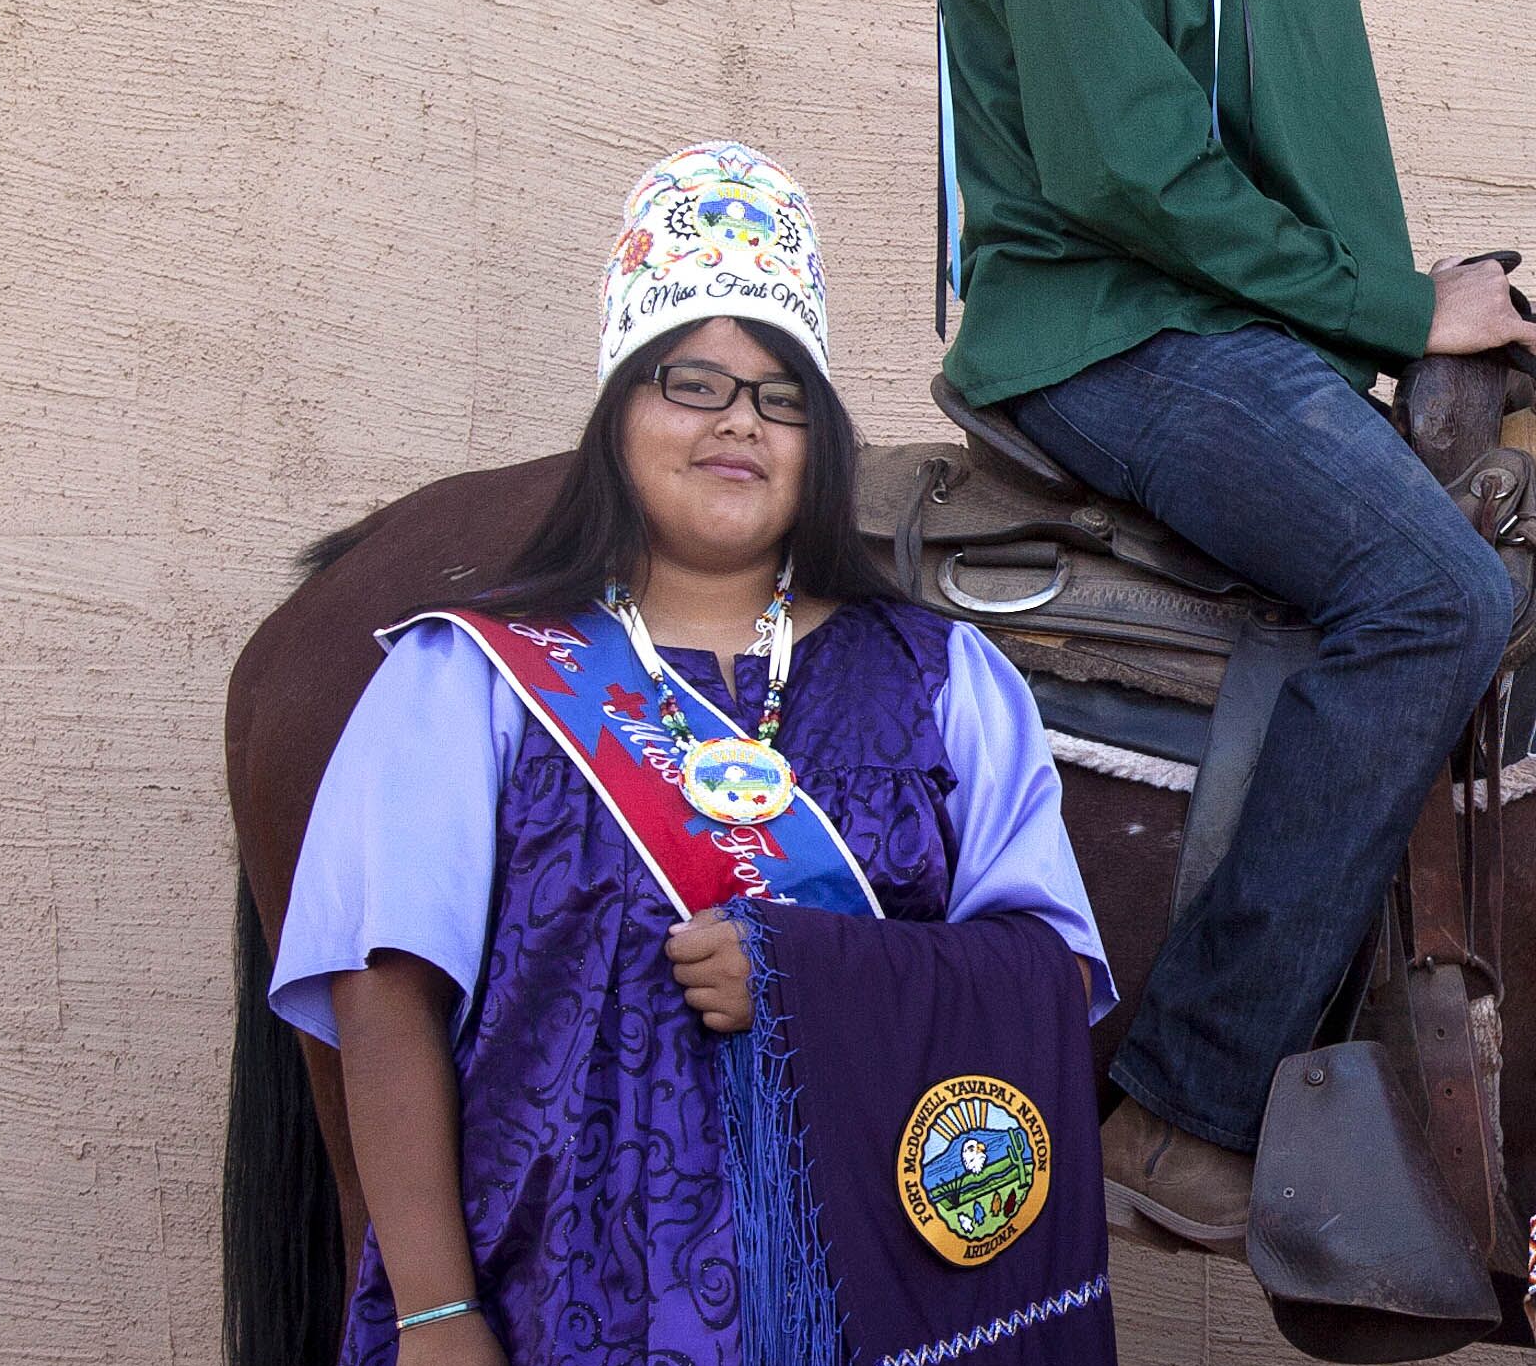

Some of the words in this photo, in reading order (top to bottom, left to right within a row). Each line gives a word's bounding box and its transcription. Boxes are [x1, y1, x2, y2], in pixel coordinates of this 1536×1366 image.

[641, 281, 697, 315] Miss
[706, 272, 767, 298] Fort
[508, 623, 588, 673] Jr.
[603, 704, 681, 785] Miss
[944, 1080, 1017, 1106] YAVAPAI
[904, 1091, 947, 1174] McDOWELL
[1017, 1102, 1048, 1172] NATION
[905, 1180, 933, 1226] FORT
[963, 1223, 1018, 1259] ARIZONA
